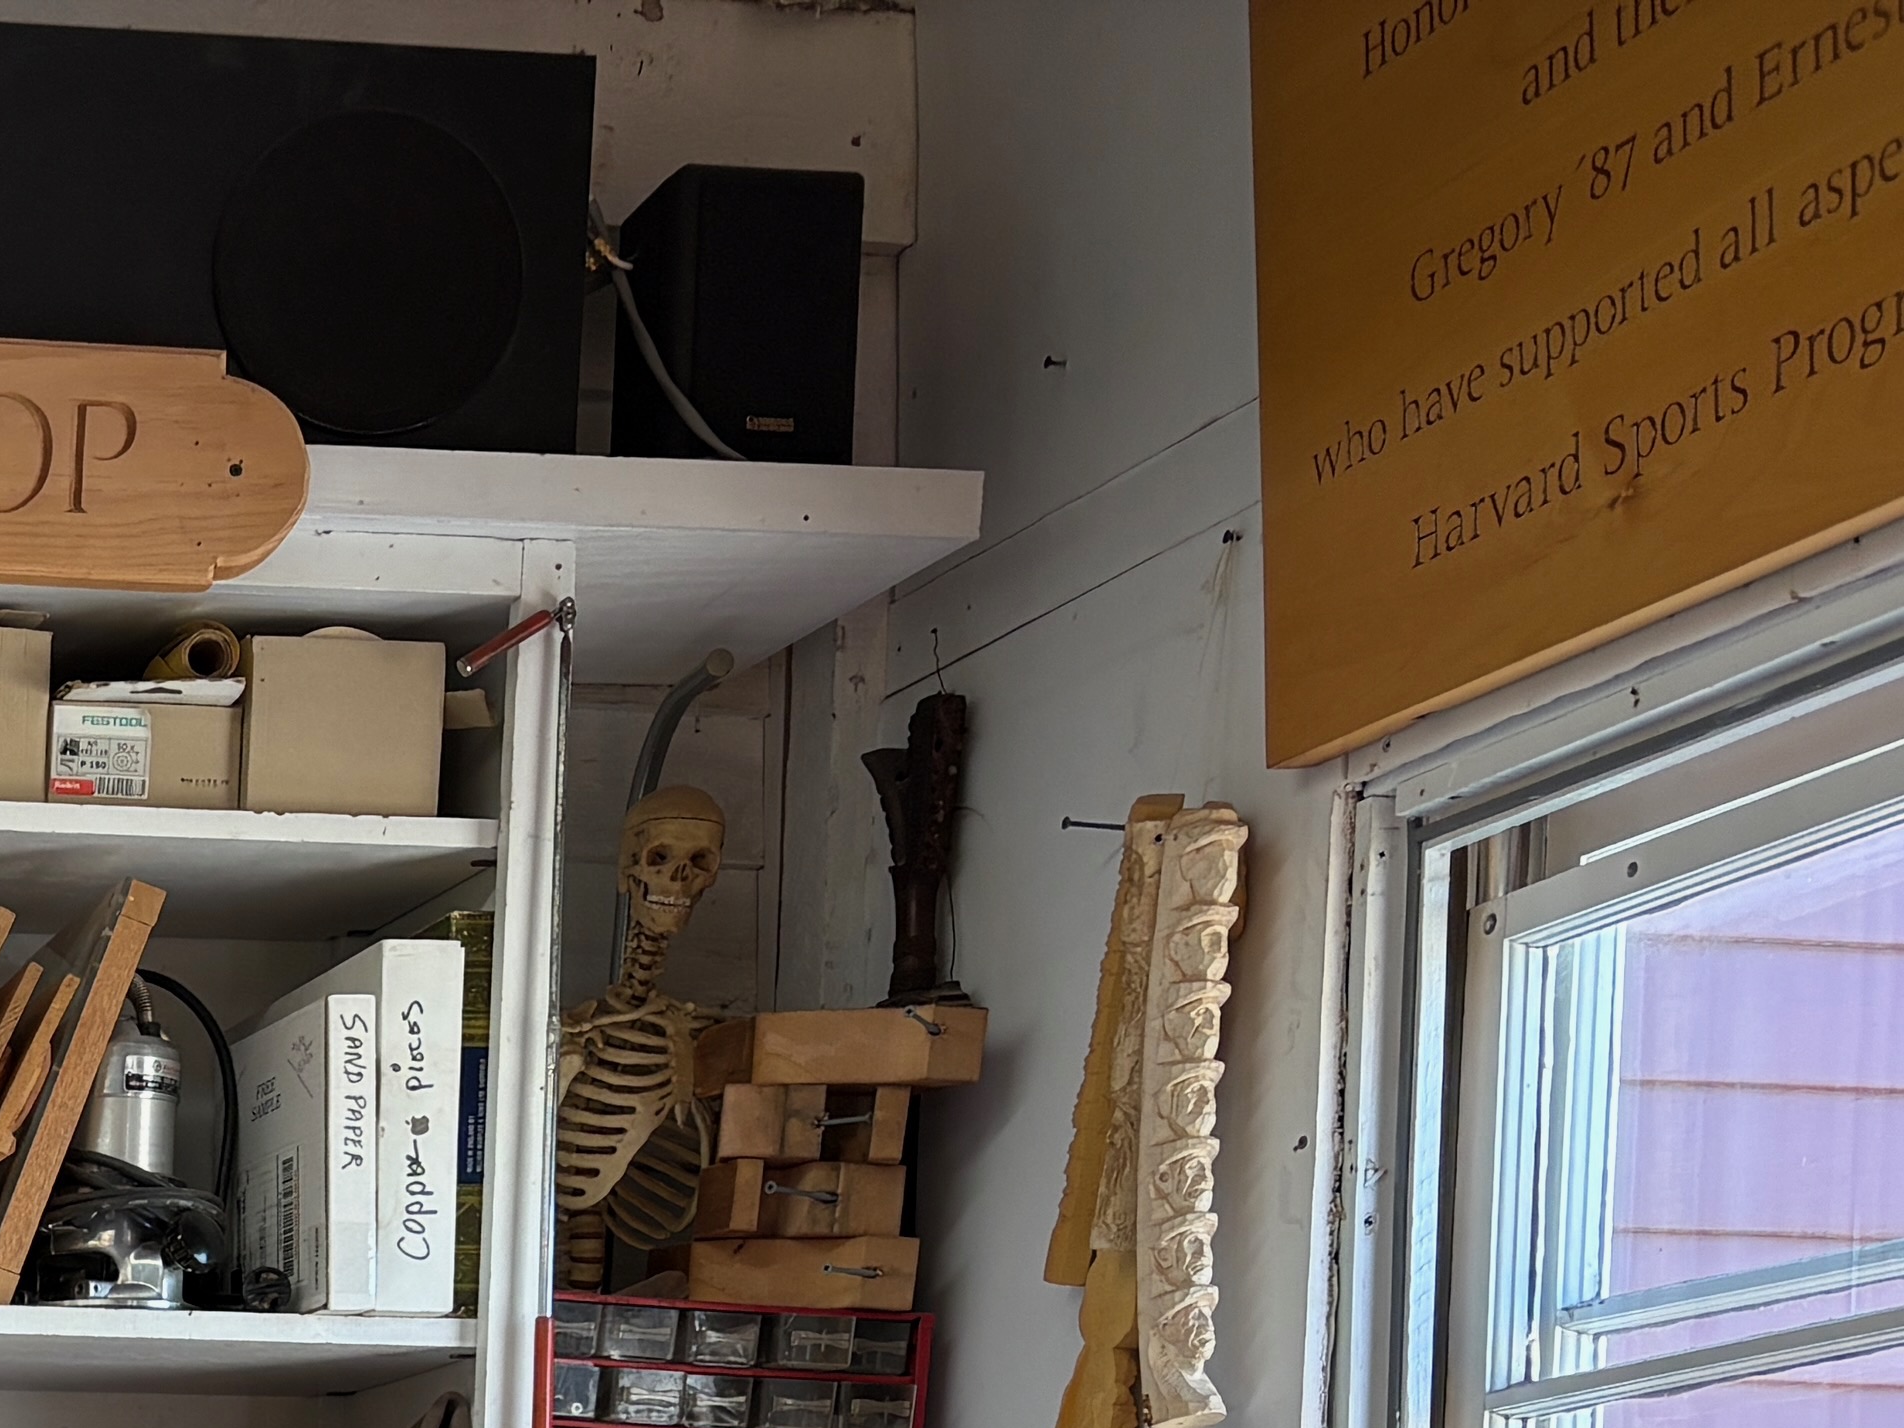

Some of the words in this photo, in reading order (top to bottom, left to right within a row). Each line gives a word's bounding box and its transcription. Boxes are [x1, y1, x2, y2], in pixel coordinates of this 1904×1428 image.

[1521, 11, 1598, 105] and
[1409, 184, 1563, 301] Gregory
[1651, 69, 1734, 165] and
[1312, 421, 1388, 486] who
[1398, 364, 1485, 440] have
[1498, 245, 1703, 388] supported
[1719, 187, 1778, 270] all
[1411, 432, 1583, 569] Harvard
[1603, 366, 1750, 477] Sports
[82, 715, 148, 728] FESTOOL
[340, 1012, 368, 1084] SAND
[250, 1093, 282, 1122] SAMPLE
[255, 1076, 277, 1101] FREE
[342, 1094, 367, 1170] PAPER
